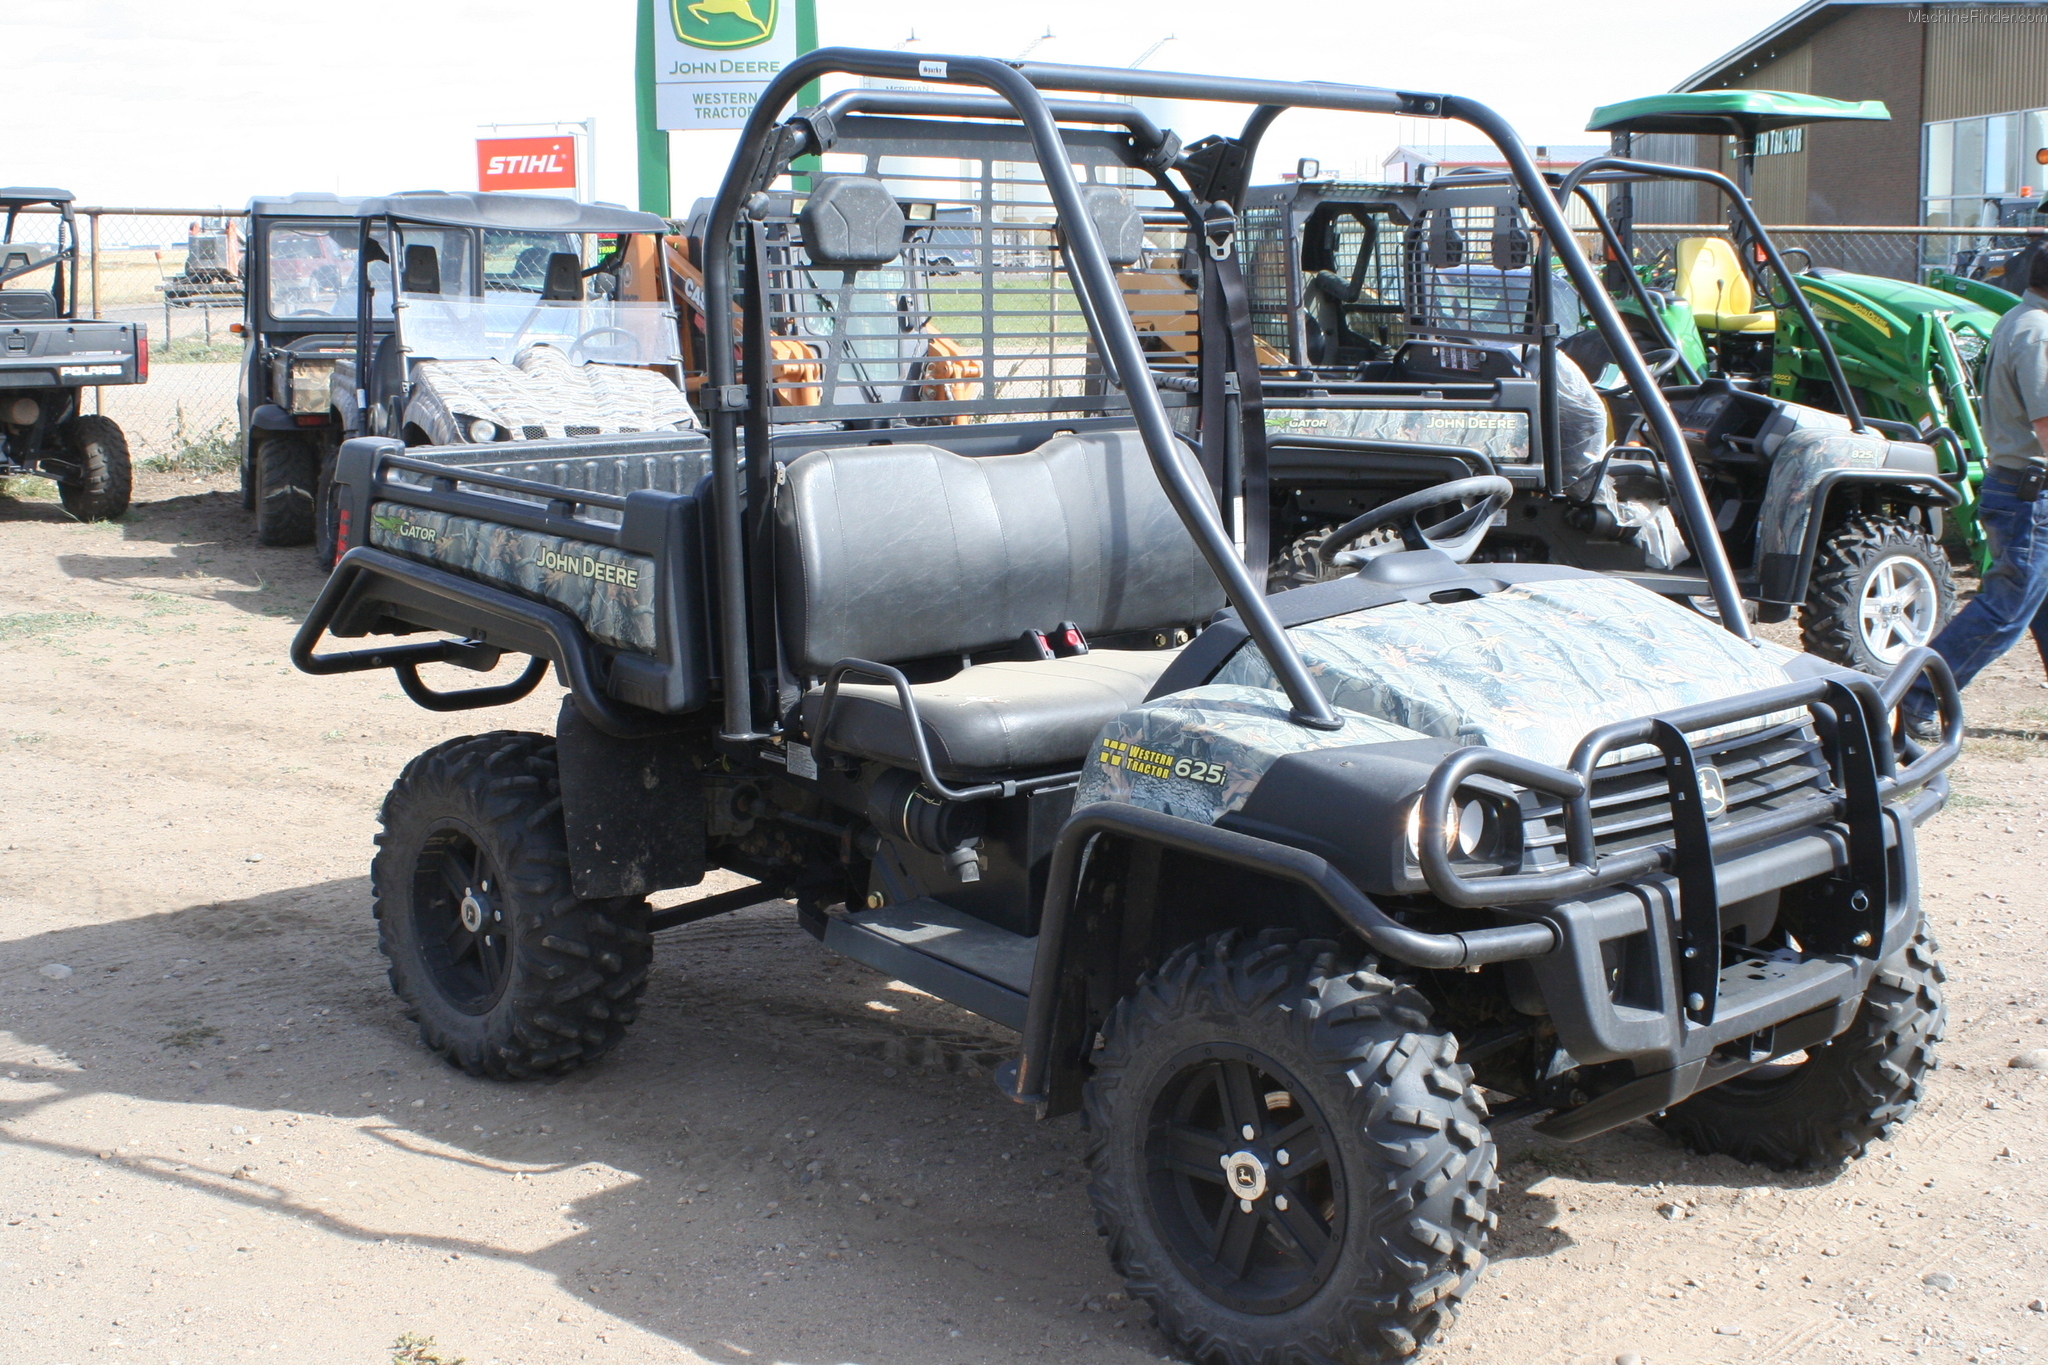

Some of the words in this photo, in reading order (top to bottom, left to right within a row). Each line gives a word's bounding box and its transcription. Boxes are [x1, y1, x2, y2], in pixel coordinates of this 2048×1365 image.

[668, 60, 717, 75] JOHN
[720, 58, 781, 74] DEERE
[692, 92, 758, 105] WESTERN
[486, 154, 564, 175] STIHL
[60, 365, 122, 376] POLARIS
[1289, 418, 1327, 428] GATOR
[1426, 416, 1466, 429] JOHN
[1468, 415, 1516, 430] DEERE
[400, 523, 436, 541] GATOR
[536, 547, 580, 576] JOHN
[582, 555, 638, 589] DEERE
[1128, 745, 1174, 767] WESTERN
[1126, 758, 1170, 779] TRACTOR
[1174, 758, 1227, 786] 625i
